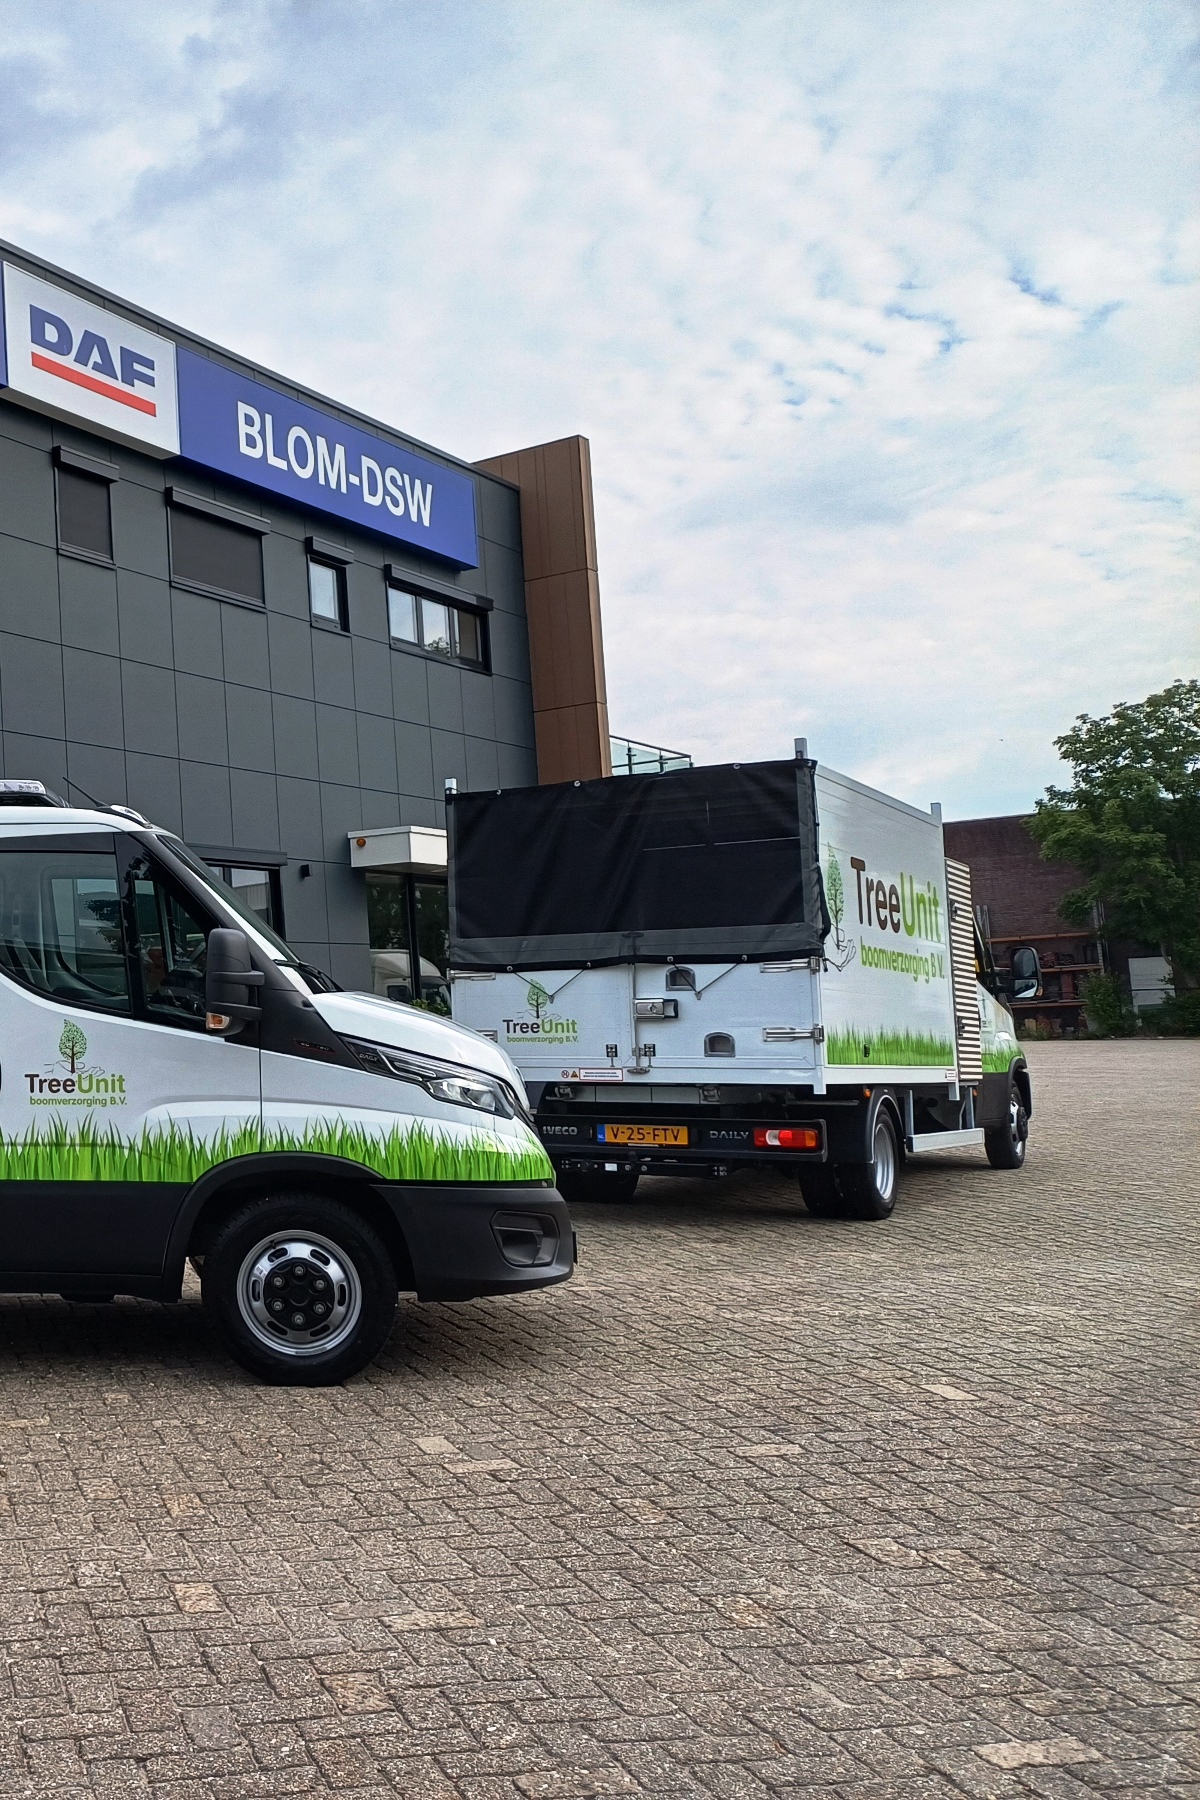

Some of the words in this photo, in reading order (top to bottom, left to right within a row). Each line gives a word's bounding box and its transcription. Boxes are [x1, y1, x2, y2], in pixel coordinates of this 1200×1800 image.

[29, 303, 156, 389] DAF
[236, 400, 434, 528] BLOM-DSW
[850, 856, 942, 944] TreeUnit
[860, 935, 930, 984] boomverzorging
[931, 952, 945, 980] BV.
[503, 1018, 578, 1034] TreeUnit
[506, 1035, 564, 1044] boomverzorging
[24, 1073, 126, 1094] TreeUnit
[29, 1095, 107, 1107] boomverzorging
[109, 1096, 128, 1106] B.V.
[542, 1125, 578, 1135] IVECO
[610, 1126, 682, 1142] V-25-FTV
[709, 1129, 749, 1140] DAILY
